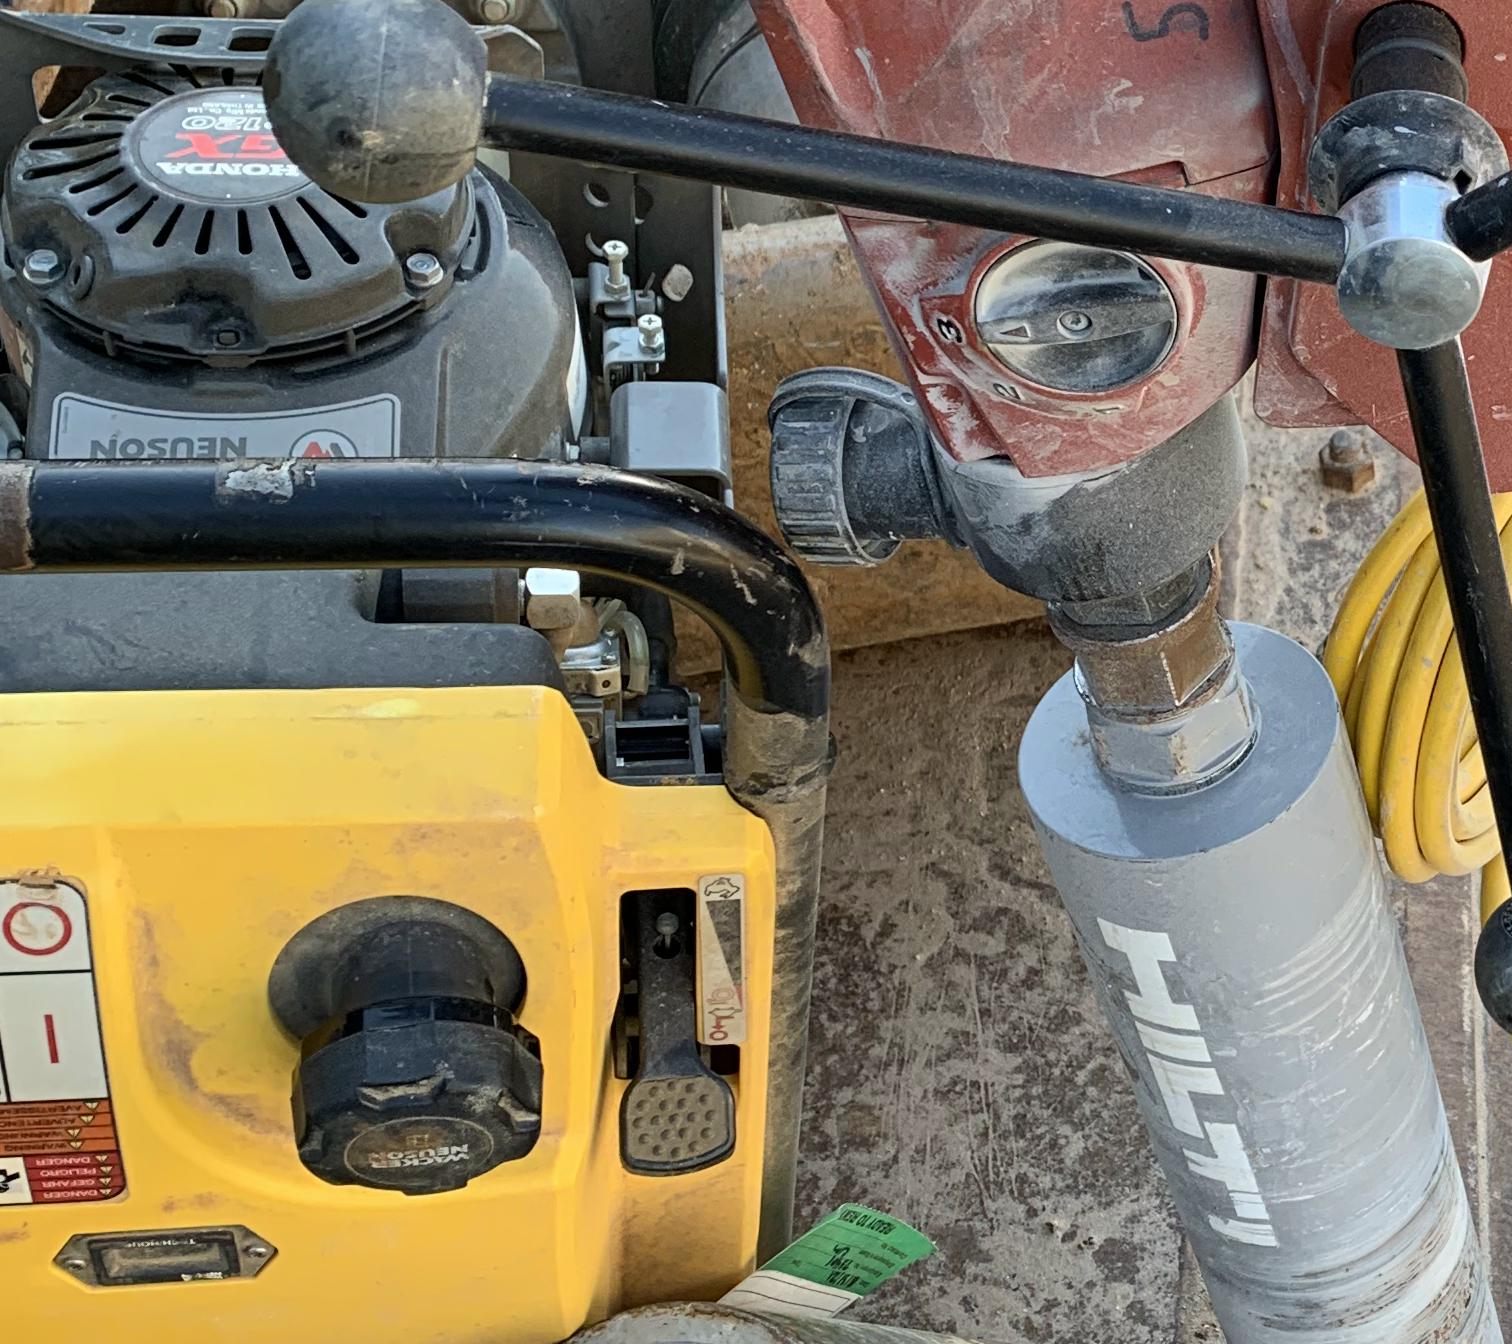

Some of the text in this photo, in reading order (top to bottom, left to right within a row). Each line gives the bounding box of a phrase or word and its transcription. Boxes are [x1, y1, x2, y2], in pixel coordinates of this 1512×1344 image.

[165, 131, 287, 158] GX
[156, 162, 300, 176] HONDA
[937, 318, 963, 343] 3
[992, 383, 1022, 400] 2
[90, 436, 247, 458] NEUSON
[1097, 917, 1278, 1247] HILTI
[35, 1156, 91, 1166] DANGER
[39, 1167, 97, 1177] PELIGRO
[41, 1178, 95, 1188] GEFAHR
[43, 1189, 98, 1199] DANGER
